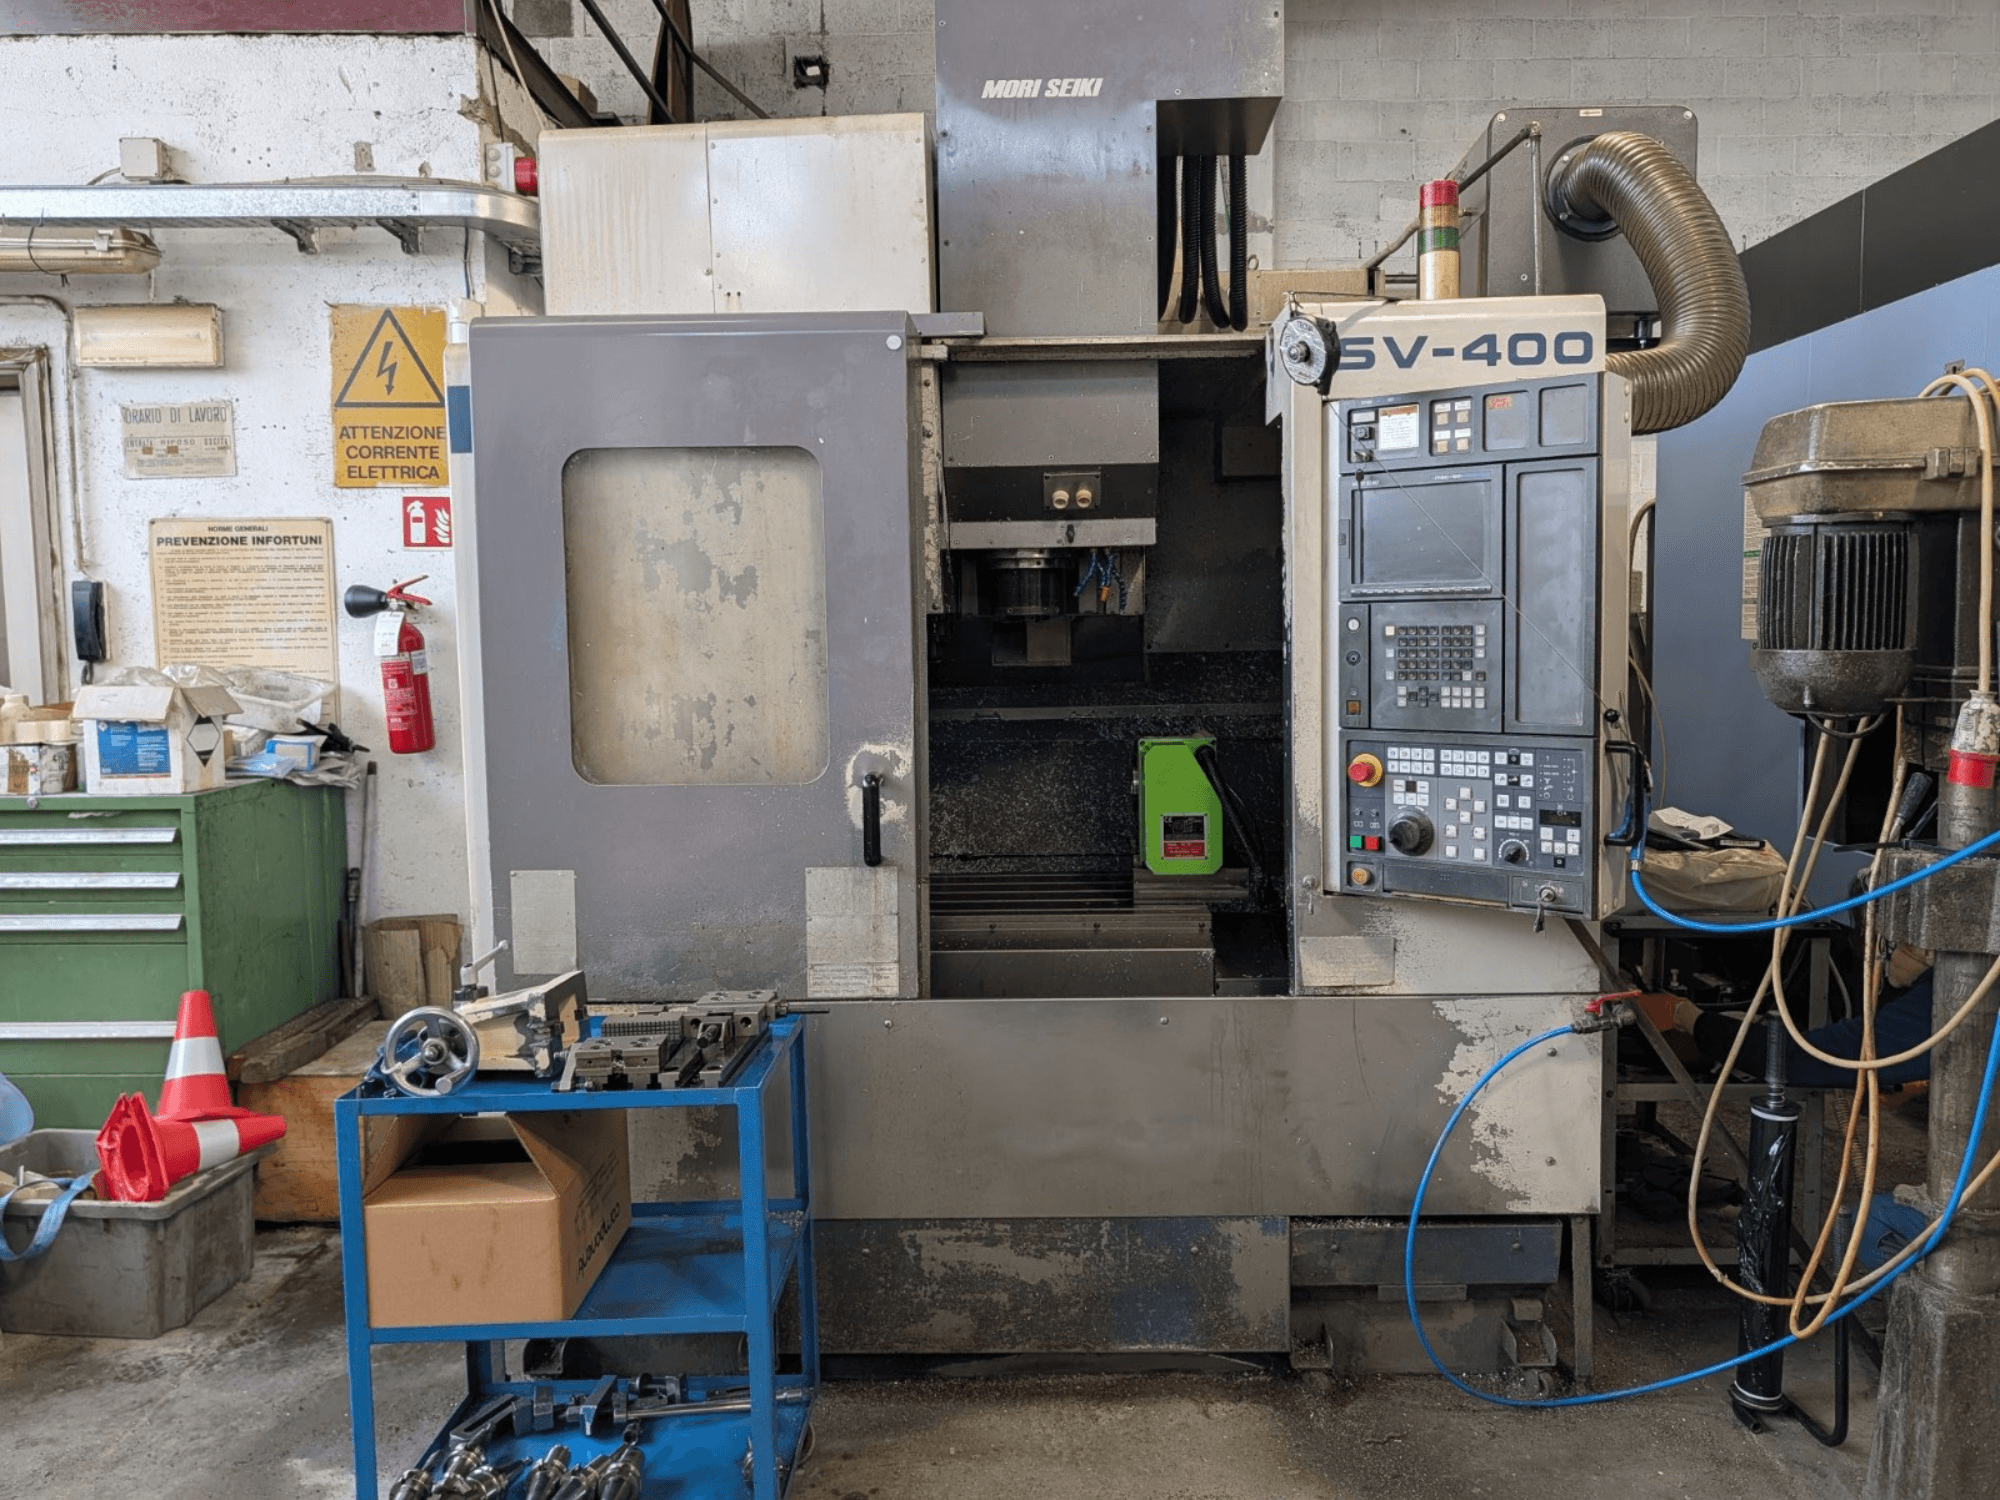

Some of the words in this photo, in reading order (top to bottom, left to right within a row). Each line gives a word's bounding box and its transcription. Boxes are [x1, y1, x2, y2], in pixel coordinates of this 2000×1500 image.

[981, 79, 1042, 99] MORI
[1044, 78, 1104, 98] SEIKI
[1337, 331, 1593, 371] SV-400
[125, 407, 162, 424] ORARIO
[170, 407, 181, 423] DI
[189, 406, 227, 423] LAVORO
[339, 425, 447, 440] ATTENZIONE
[346, 445, 440, 459] CORRENTE
[347, 465, 440, 479] ELETTRICA
[156, 536, 248, 546] PREVENZIONE
[252, 535, 322, 545] INFORTUNI
